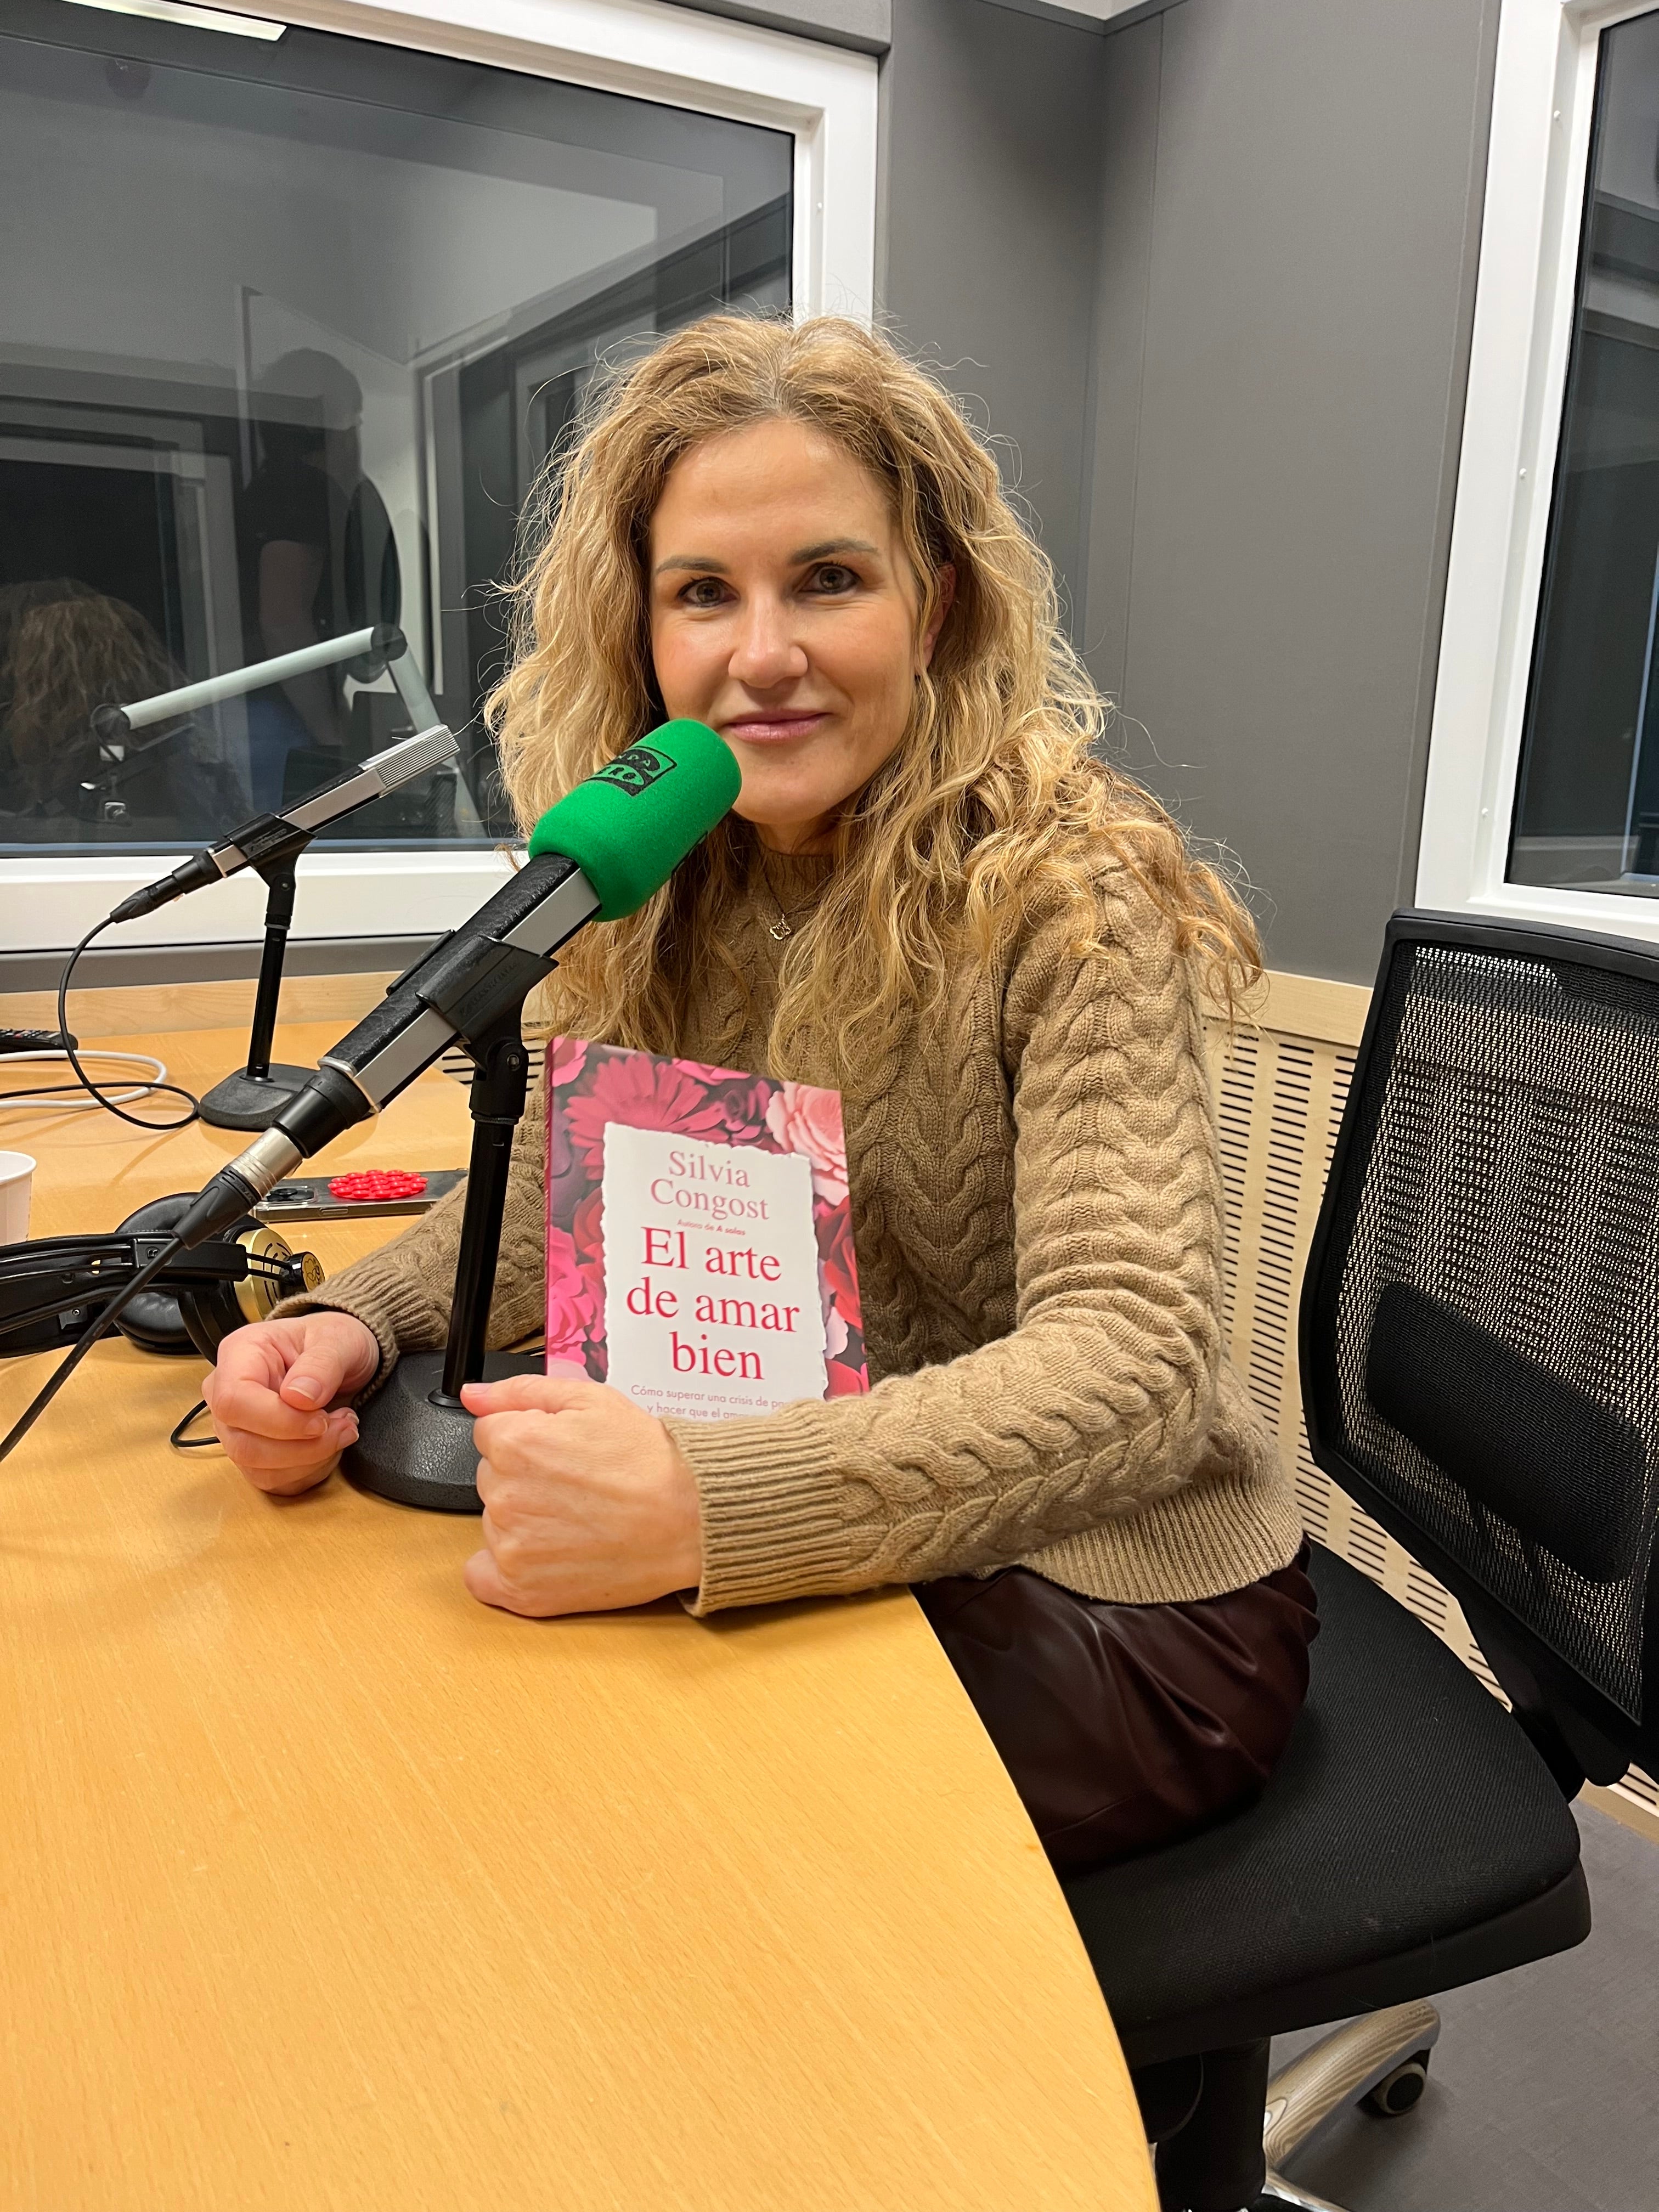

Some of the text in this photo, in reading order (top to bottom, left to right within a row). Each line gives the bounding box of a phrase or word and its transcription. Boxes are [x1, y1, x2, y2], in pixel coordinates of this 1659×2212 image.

[669, 1150, 751, 1188] Silvia
[651, 1178, 770, 1220] Congost
[725, 1227, 746, 1235] solas
[640, 1226, 781, 1282] El arte
[625, 1277, 800, 1333] de amar
[669, 1331, 766, 1381] bien
[631, 1385, 663, 1397] Cómo
[667, 1390, 706, 1401] superar
[708, 1394, 726, 1403] una
[729, 1395, 753, 1406] crisis
[755, 1396, 769, 1407] de
[647, 1405, 653, 1414] y
[657, 1402, 686, 1414] hacer
[689, 1408, 708, 1419] que
[711, 1408, 720, 1418] el
